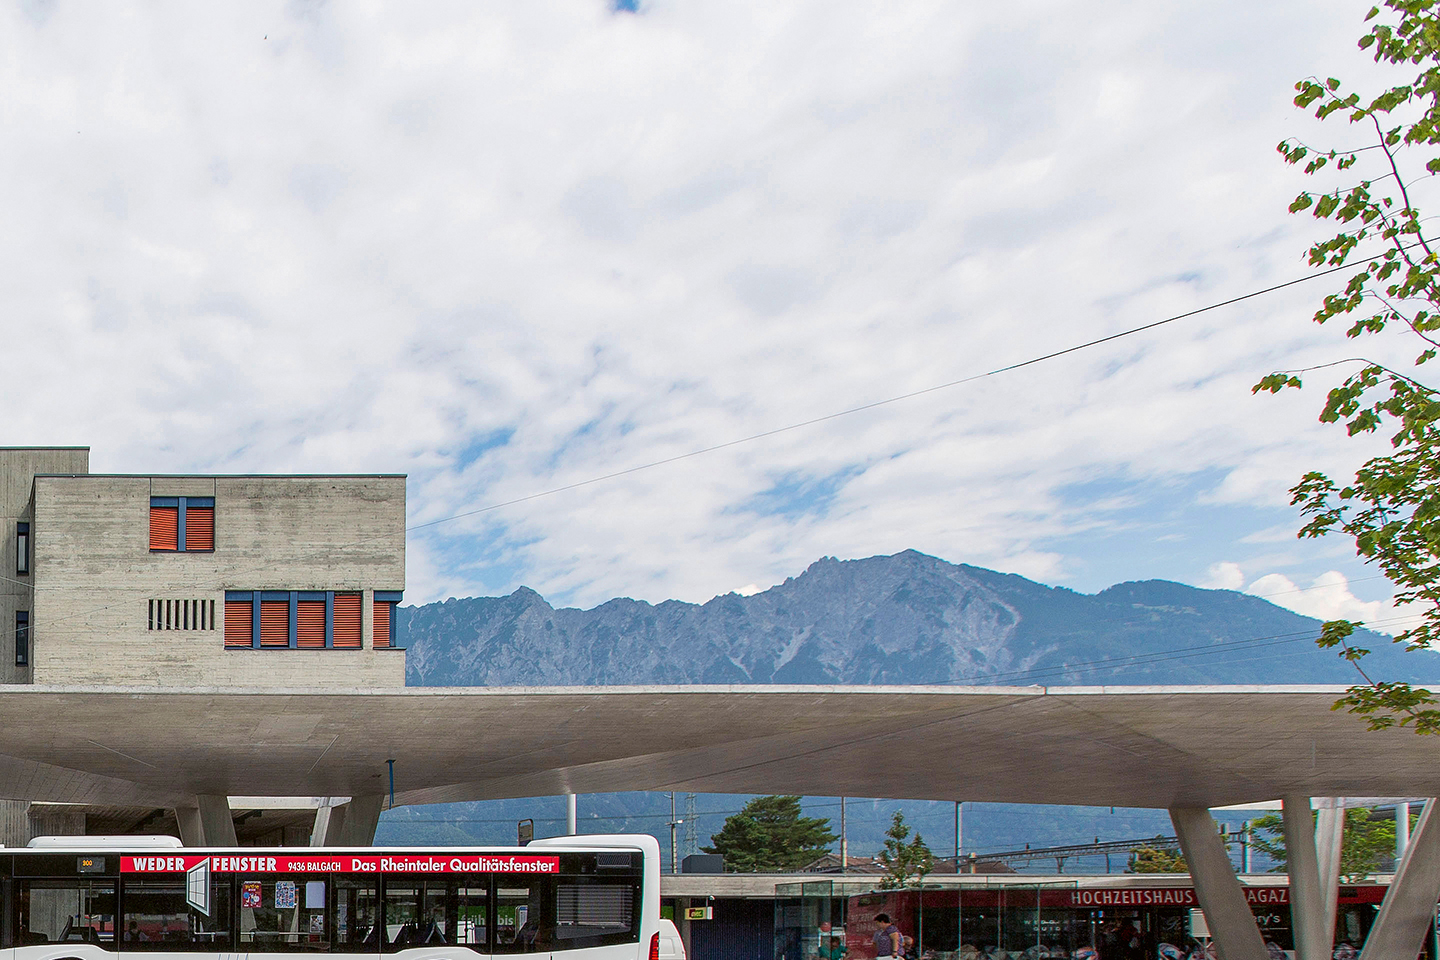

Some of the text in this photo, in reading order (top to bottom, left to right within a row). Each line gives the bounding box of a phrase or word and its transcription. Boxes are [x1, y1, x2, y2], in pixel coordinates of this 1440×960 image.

[133, 857, 277, 871] WEDER FENSTER
[287, 861, 341, 871] 9436 BALGACH
[351, 858, 555, 872] Das Rheintaler Qualitätsfenster
[1071, 889, 1288, 904] HOCHZEITSHAUS AGAZ
[1255, 912, 1281, 926] ry's
